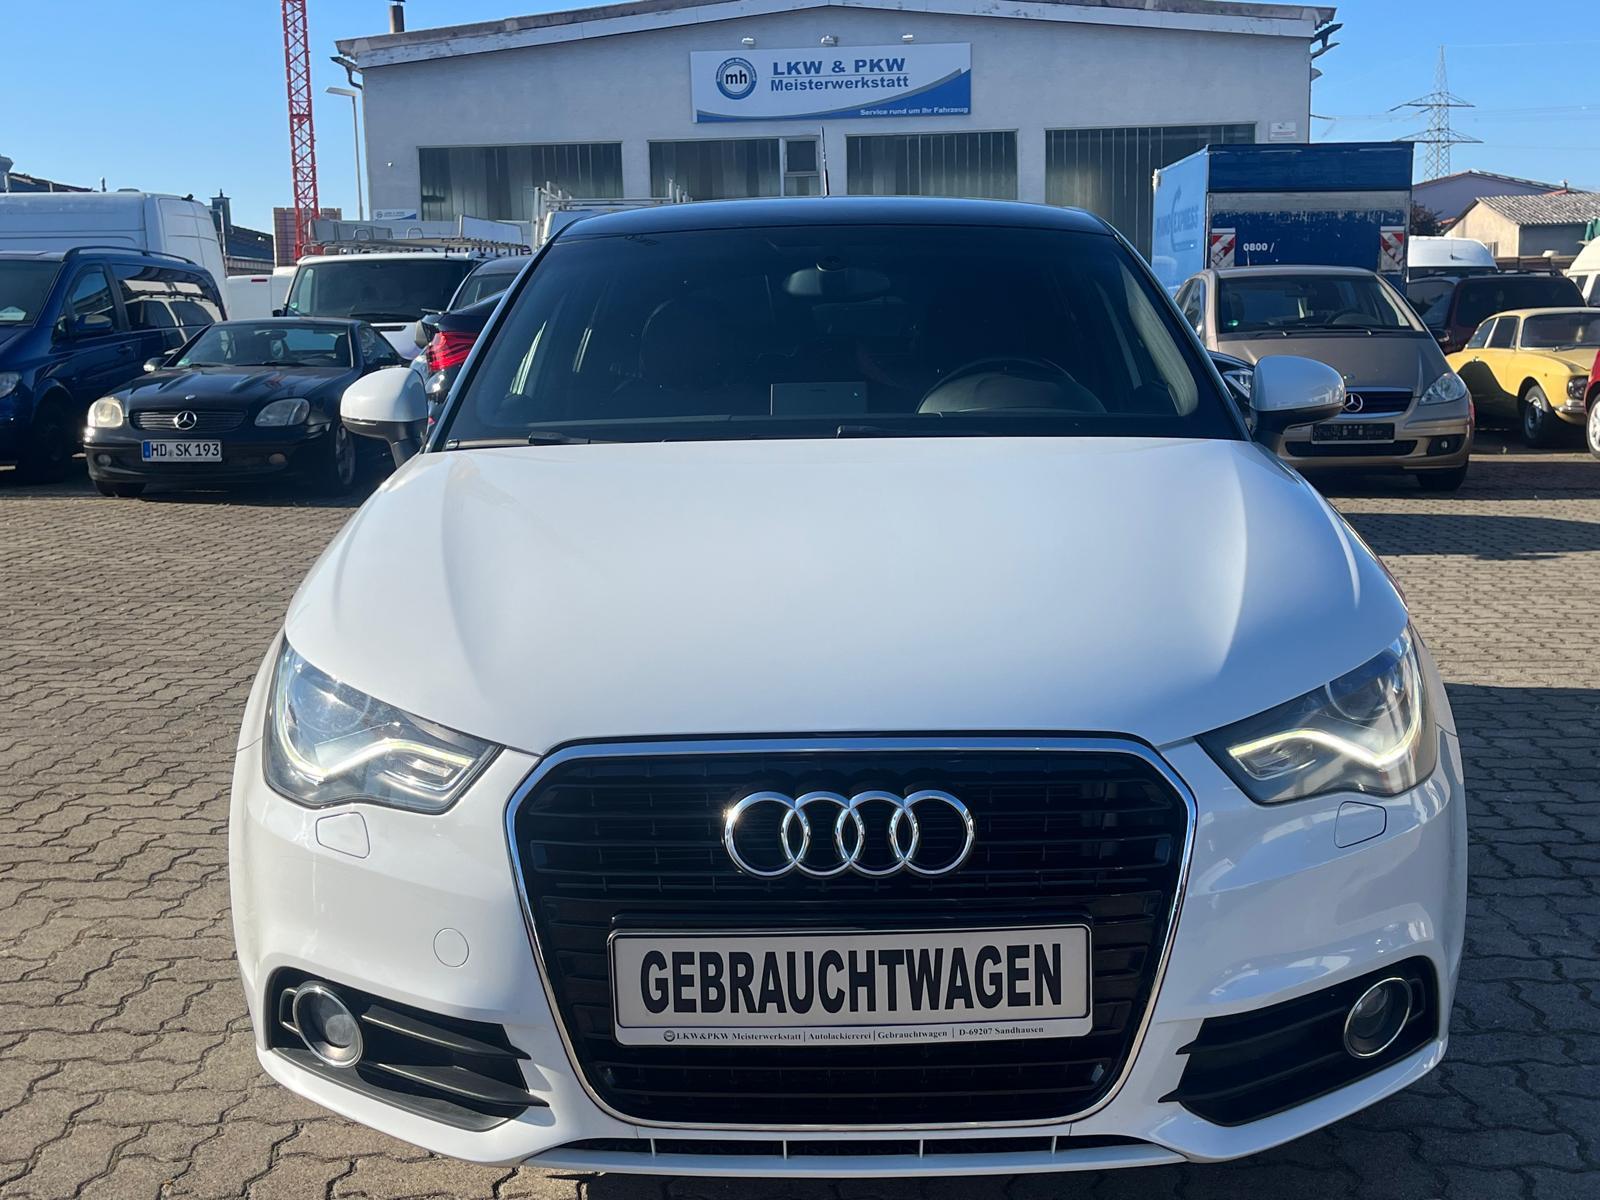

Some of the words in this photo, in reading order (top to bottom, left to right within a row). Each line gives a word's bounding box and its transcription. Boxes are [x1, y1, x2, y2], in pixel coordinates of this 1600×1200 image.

[772, 60, 823, 76] LKW
[831, 60, 846, 74] &
[854, 57, 906, 73] PKW
[725, 70, 748, 85] mh
[770, 75, 909, 92] Meisterwerkstatt
[933, 106, 969, 114] Fahrzeug
[1243, 242, 1268, 251] 0800
[151, 443, 167, 457] HD
[175, 443, 192, 457] SK
[194, 443, 220, 457] 193
[640, 943, 1062, 1014] GEBRAUCHTWAGEN
[731, 1031, 801, 1041] Meisterwerkstatt
[808, 1031, 871, 1041] Autolackiererei
[877, 1030, 948, 1040] Gebrauchtwagen
[959, 1027, 993, 1036] D-69207
[994, 1025, 1044, 1035] Sandhausen
